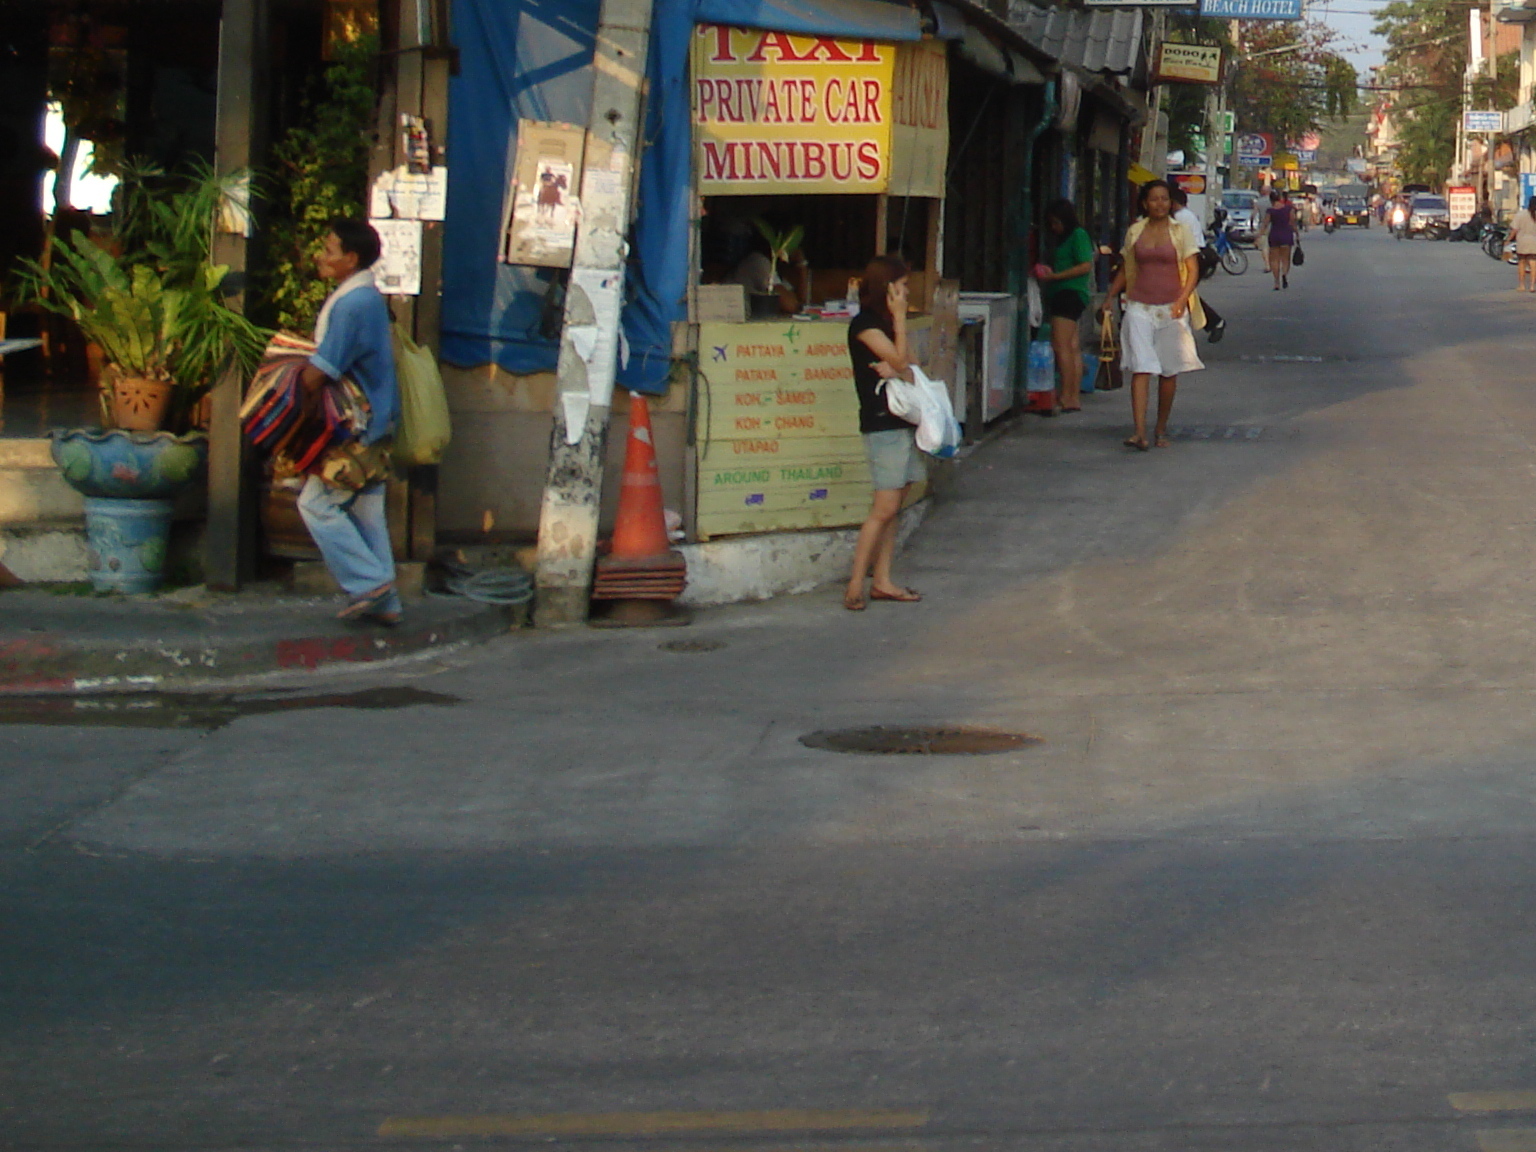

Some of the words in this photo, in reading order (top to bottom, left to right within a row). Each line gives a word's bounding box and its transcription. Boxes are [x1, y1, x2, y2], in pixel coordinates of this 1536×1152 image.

[1251, 0, 1296, 14] HOTEL
[699, 24, 881, 61] TAXI
[1164, 48, 1200, 57] DODO
[697, 79, 817, 123] PRIVATE
[824, 79, 882, 123] CAR
[702, 142, 881, 180] MINIBUS
[736, 344, 785, 358] PATTAYA
[805, 343, 848, 357] AIRPOR
[804, 367, 855, 381] BANGKO
[735, 392, 761, 406] KOH
[776, 391, 816, 405] SAMED
[735, 416, 761, 430] KOH
[774, 415, 815, 430] CHANG
[733, 439, 779, 455] UTAPAO
[714, 470, 770, 486] AROUND
[780, 466, 843, 481] THAILAND
